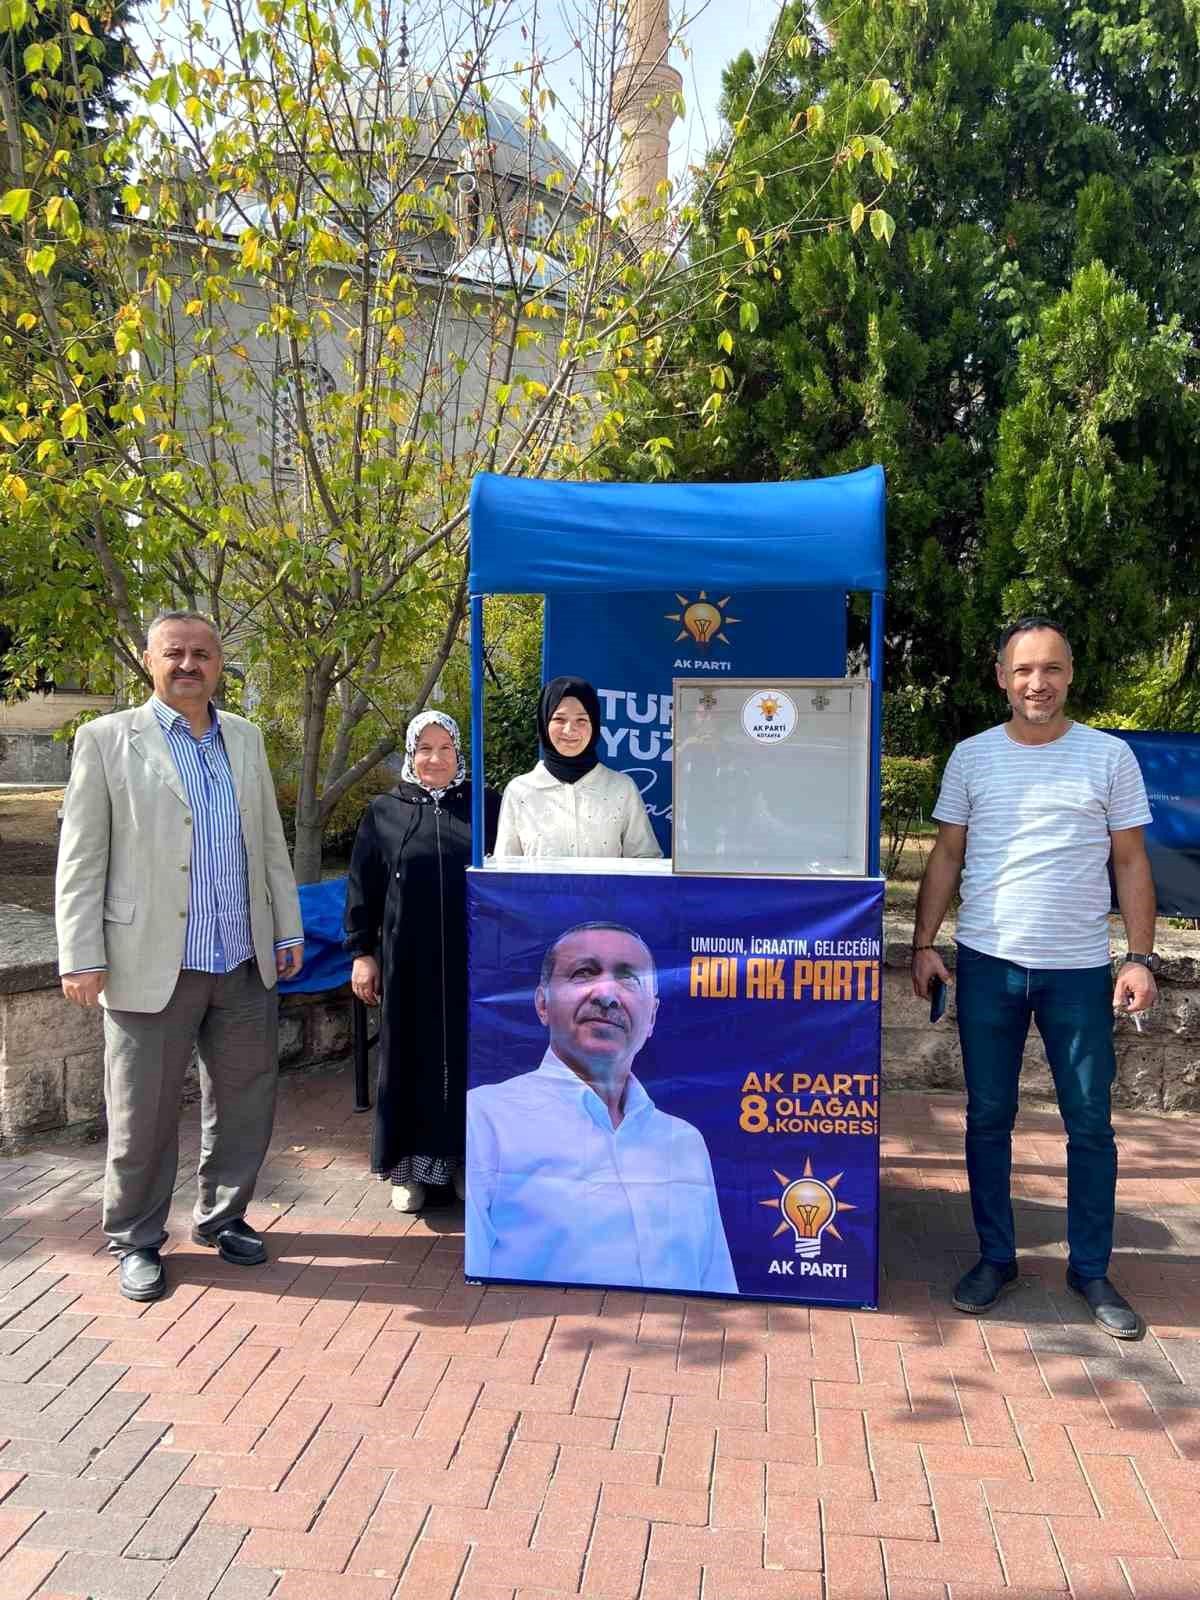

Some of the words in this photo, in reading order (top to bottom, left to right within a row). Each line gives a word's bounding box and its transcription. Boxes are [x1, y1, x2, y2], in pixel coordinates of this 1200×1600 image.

[673, 659, 692, 669] AK
[691, 937, 747, 956] UMUDUN,
[751, 936, 811, 958] İCRAATIN,
[815, 937, 880, 957] GELECEĞİN
[690, 957, 737, 998] ADI
[746, 958, 785, 1000] AK
[741, 1072, 784, 1093] AK
[739, 1094, 775, 1133] 8.
[775, 1097, 878, 1118] OLAĞAN
[768, 1260, 794, 1275] AK
